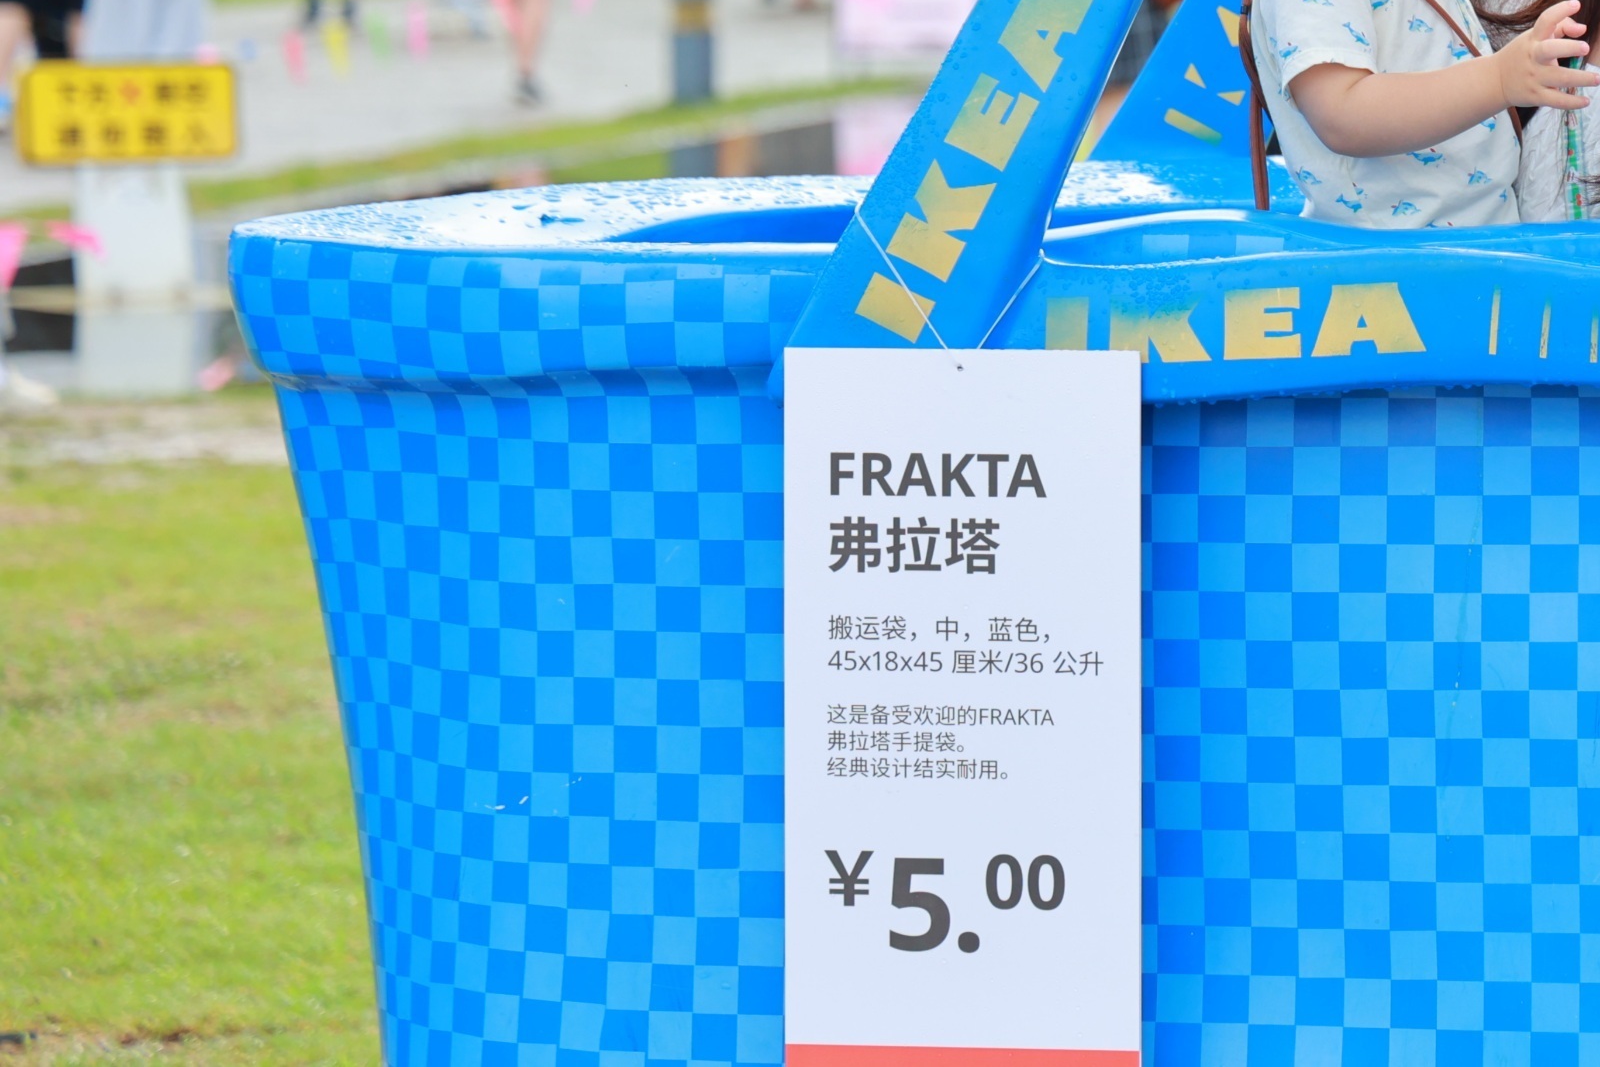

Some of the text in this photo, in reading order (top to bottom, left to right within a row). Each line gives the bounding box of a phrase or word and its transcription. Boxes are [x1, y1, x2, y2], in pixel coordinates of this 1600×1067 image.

[1046, 282, 1427, 364] IKEA
[829, 452, 1047, 498] FRAKTA
[828, 516, 1000, 574] 弗拉塔
[827, 649, 1104, 676] 45x18x45 厘米/36 公升
[826, 704, 1055, 726] 这是备受欢迎的FRAKTA
[827, 731, 965, 753] 弗拉塔手提袋。
[826, 757, 1009, 780] 经典设计结实耐用。
